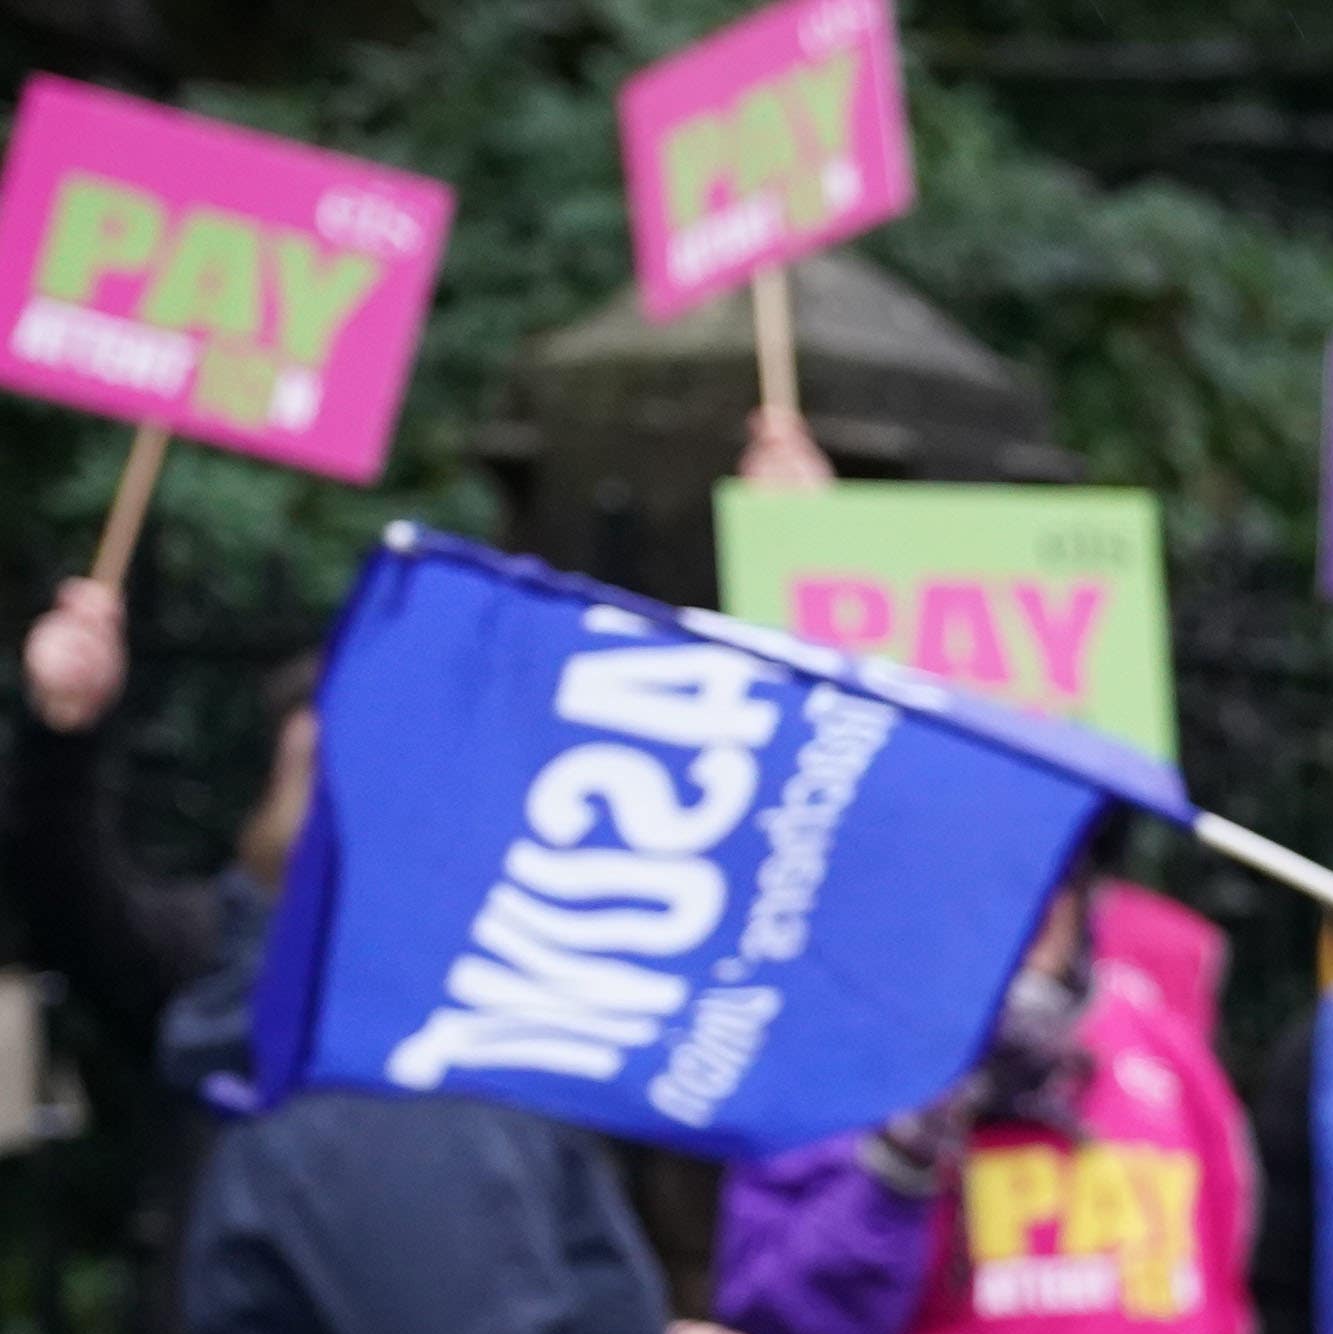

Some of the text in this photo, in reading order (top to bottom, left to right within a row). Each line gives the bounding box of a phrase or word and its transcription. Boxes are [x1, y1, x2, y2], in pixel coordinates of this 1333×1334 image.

[664, 56, 858, 226] PAY
[38, 180, 382, 368] PAY
[788, 574, 1108, 705] PAY
[963, 1140, 1200, 1266] PAY
